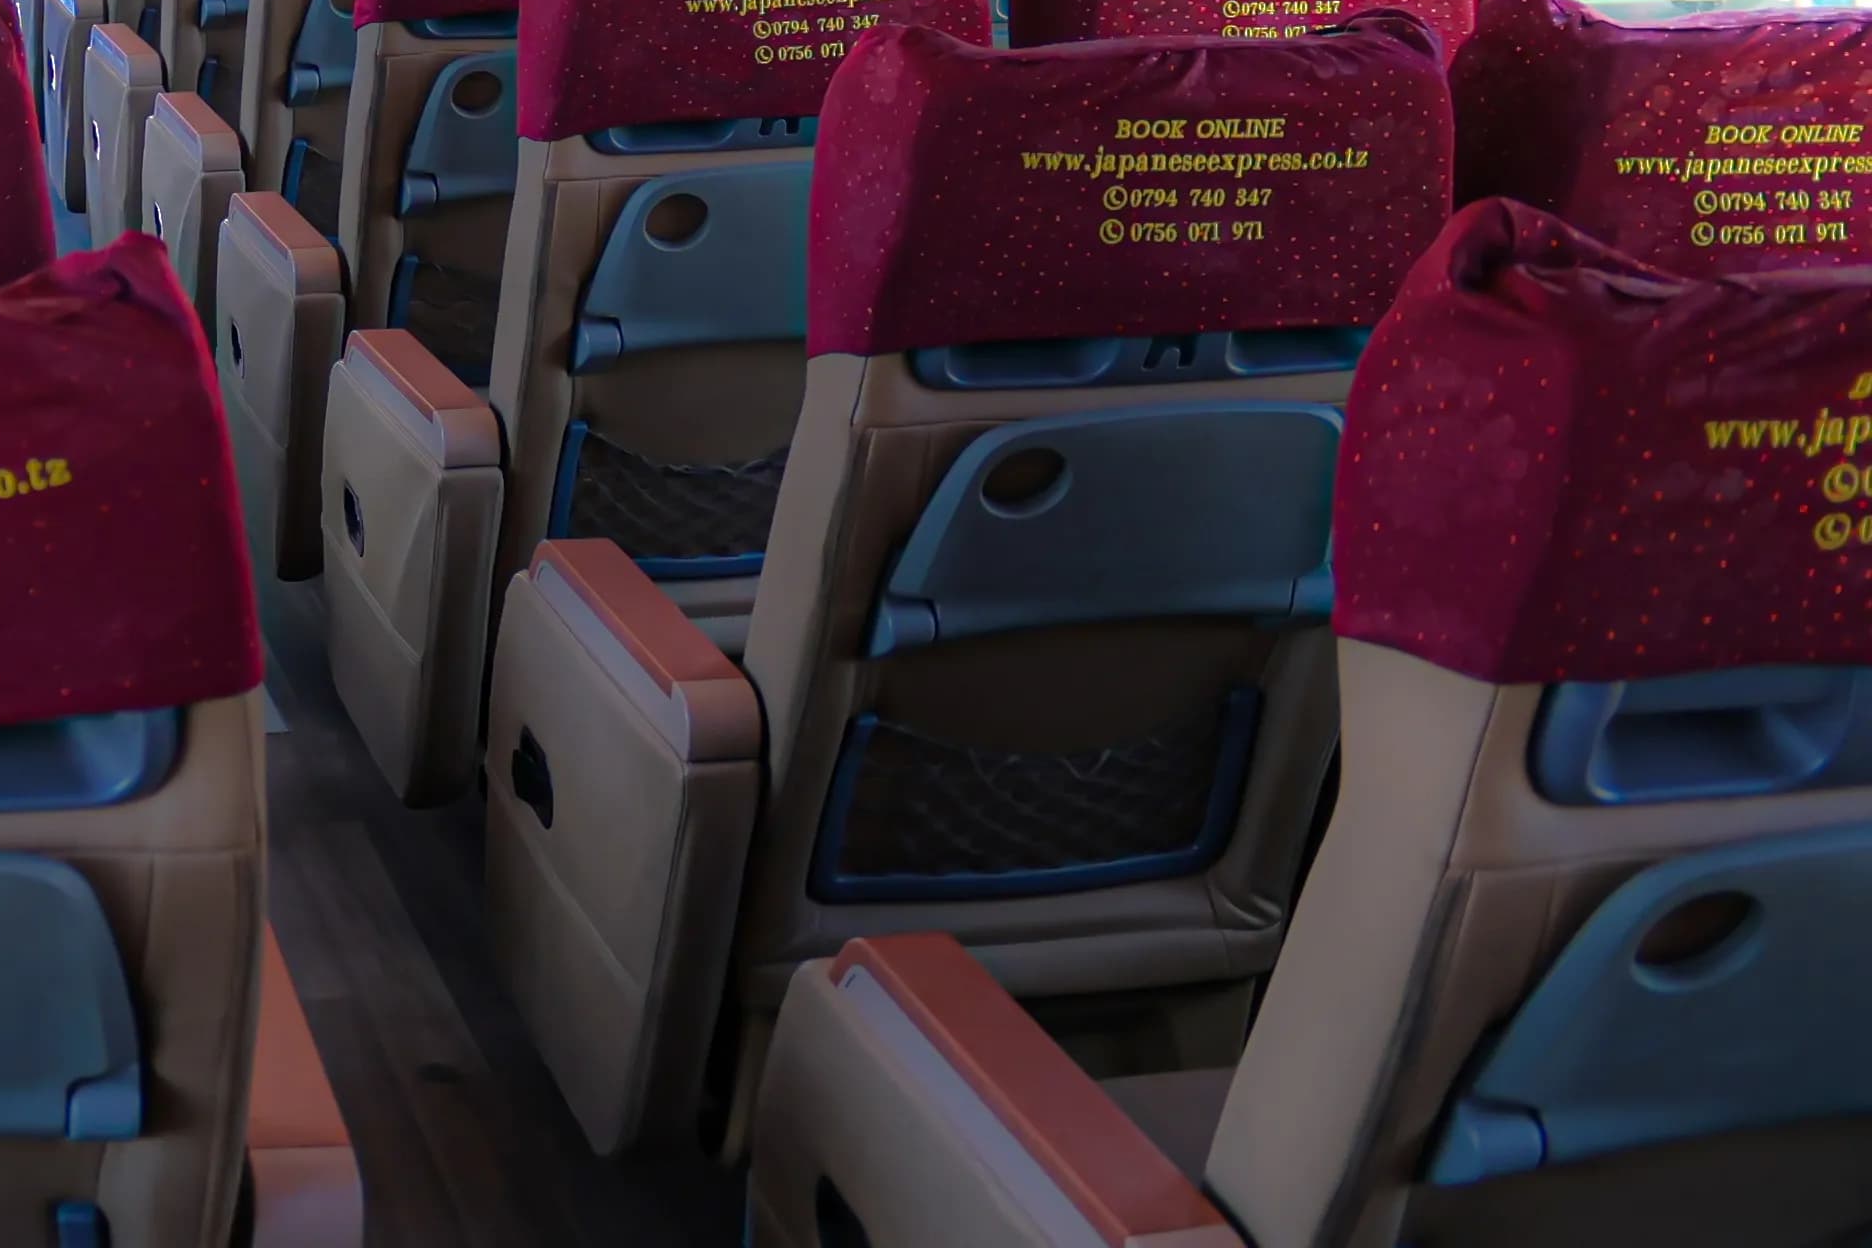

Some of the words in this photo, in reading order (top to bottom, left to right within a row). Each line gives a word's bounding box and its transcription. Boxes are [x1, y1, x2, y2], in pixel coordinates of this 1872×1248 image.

[1241, 2, 1275, 15] 0794
[1283, 1, 1308, 15] 740
[1315, 0, 1340, 14] 347
[774, 18, 809, 35] 0794
[817, 16, 845, 32] 740
[853, 14, 880, 30] 347
[778, 45, 813, 61] 0756
[821, 41, 845, 58] 071
[1114, 119, 1188, 140] BOOK
[1196, 118, 1286, 139] ONLINE
[1705, 125, 1773, 145] BOOK
[1781, 125, 1864, 144] ONLINE
[1021, 144, 1369, 180] www.japaneseexpress.co.tz
[1130, 188, 1178, 207] 0794
[1189, 188, 1226, 207] 740
[1235, 188, 1273, 207] 347
[1719, 193, 1767, 211] 0794
[1776, 191, 1810, 209] 740
[1819, 190, 1852, 209] 347
[1130, 221, 1177, 243] 0756
[1188, 221, 1221, 242] 071
[1232, 220, 1266, 241] 971
[1720, 225, 1765, 244] 0756
[1776, 224, 1806, 244] 071
[1816, 222, 1848, 242] 971
